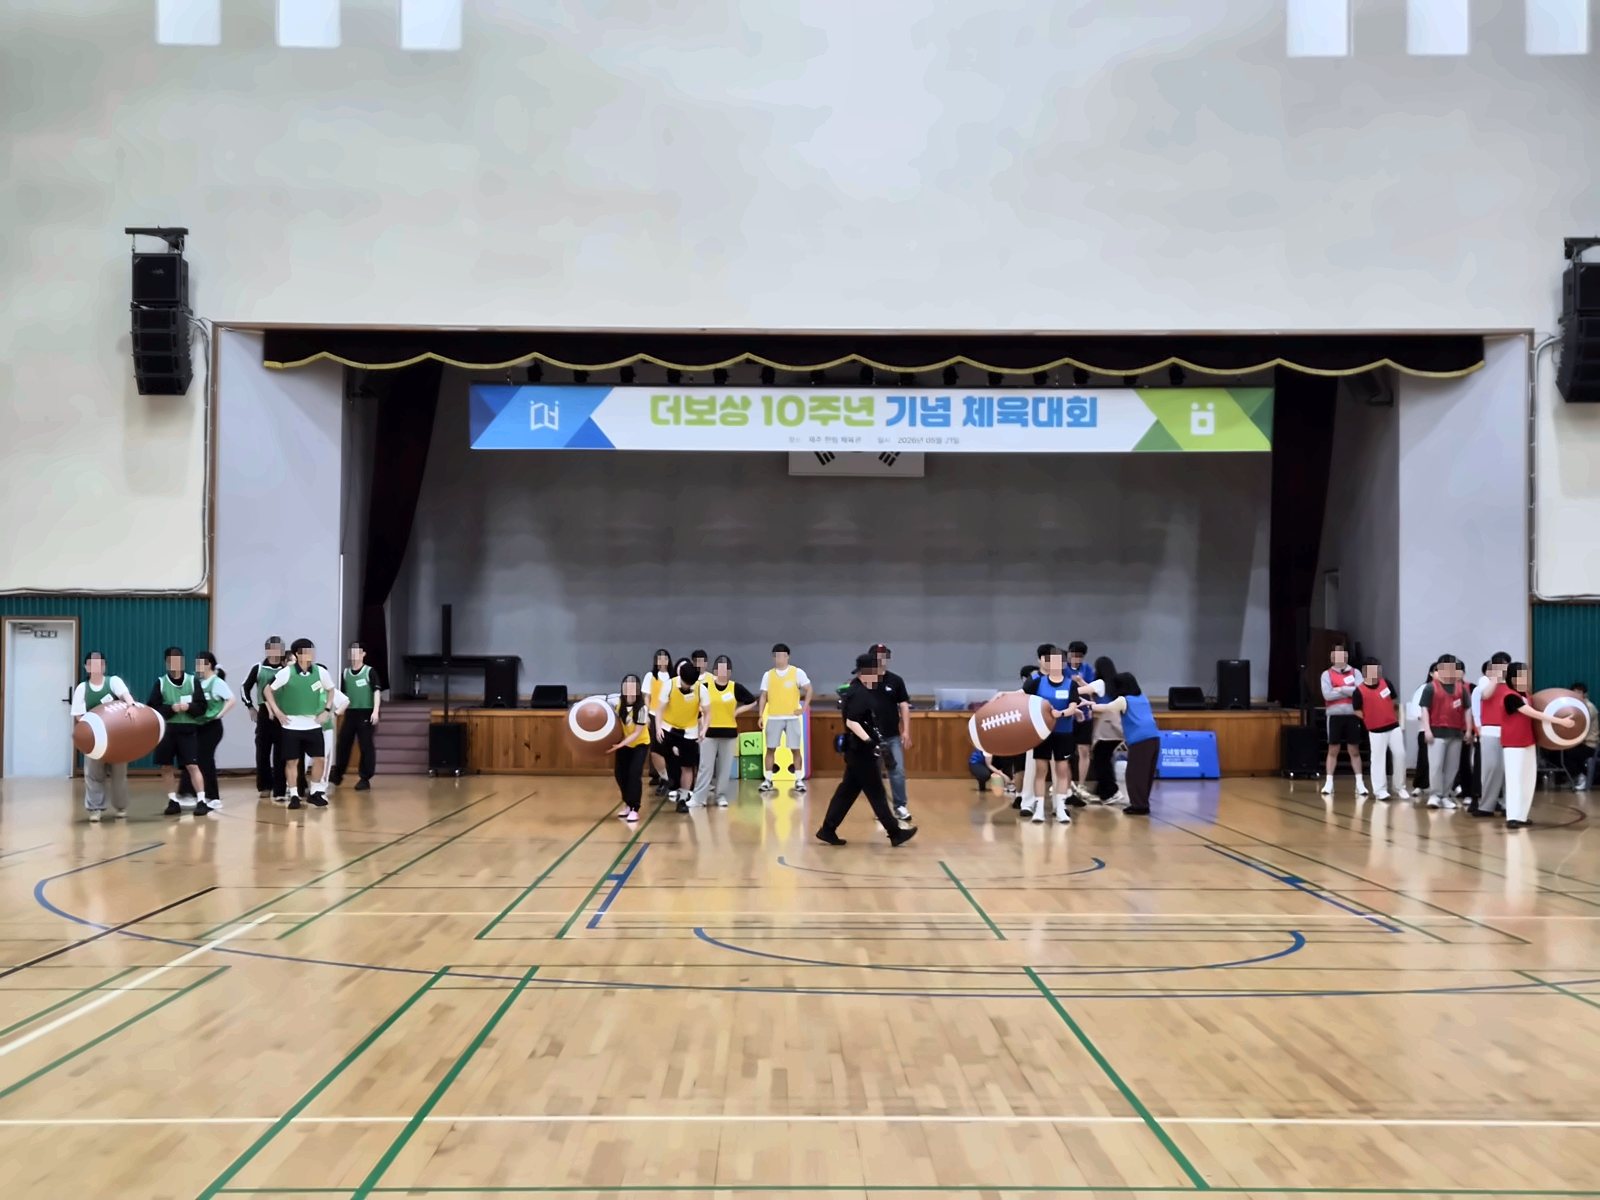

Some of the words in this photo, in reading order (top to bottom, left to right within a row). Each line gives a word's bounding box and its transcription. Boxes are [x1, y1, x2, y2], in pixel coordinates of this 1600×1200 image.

[650, 395, 751, 426] 더보상
[762, 395, 874, 427] 10주년
[885, 395, 951, 429] 기념
[962, 395, 1098, 429] 체육대회
[897, 436, 924, 444] 2026년
[743, 739, 755, 747] 2
